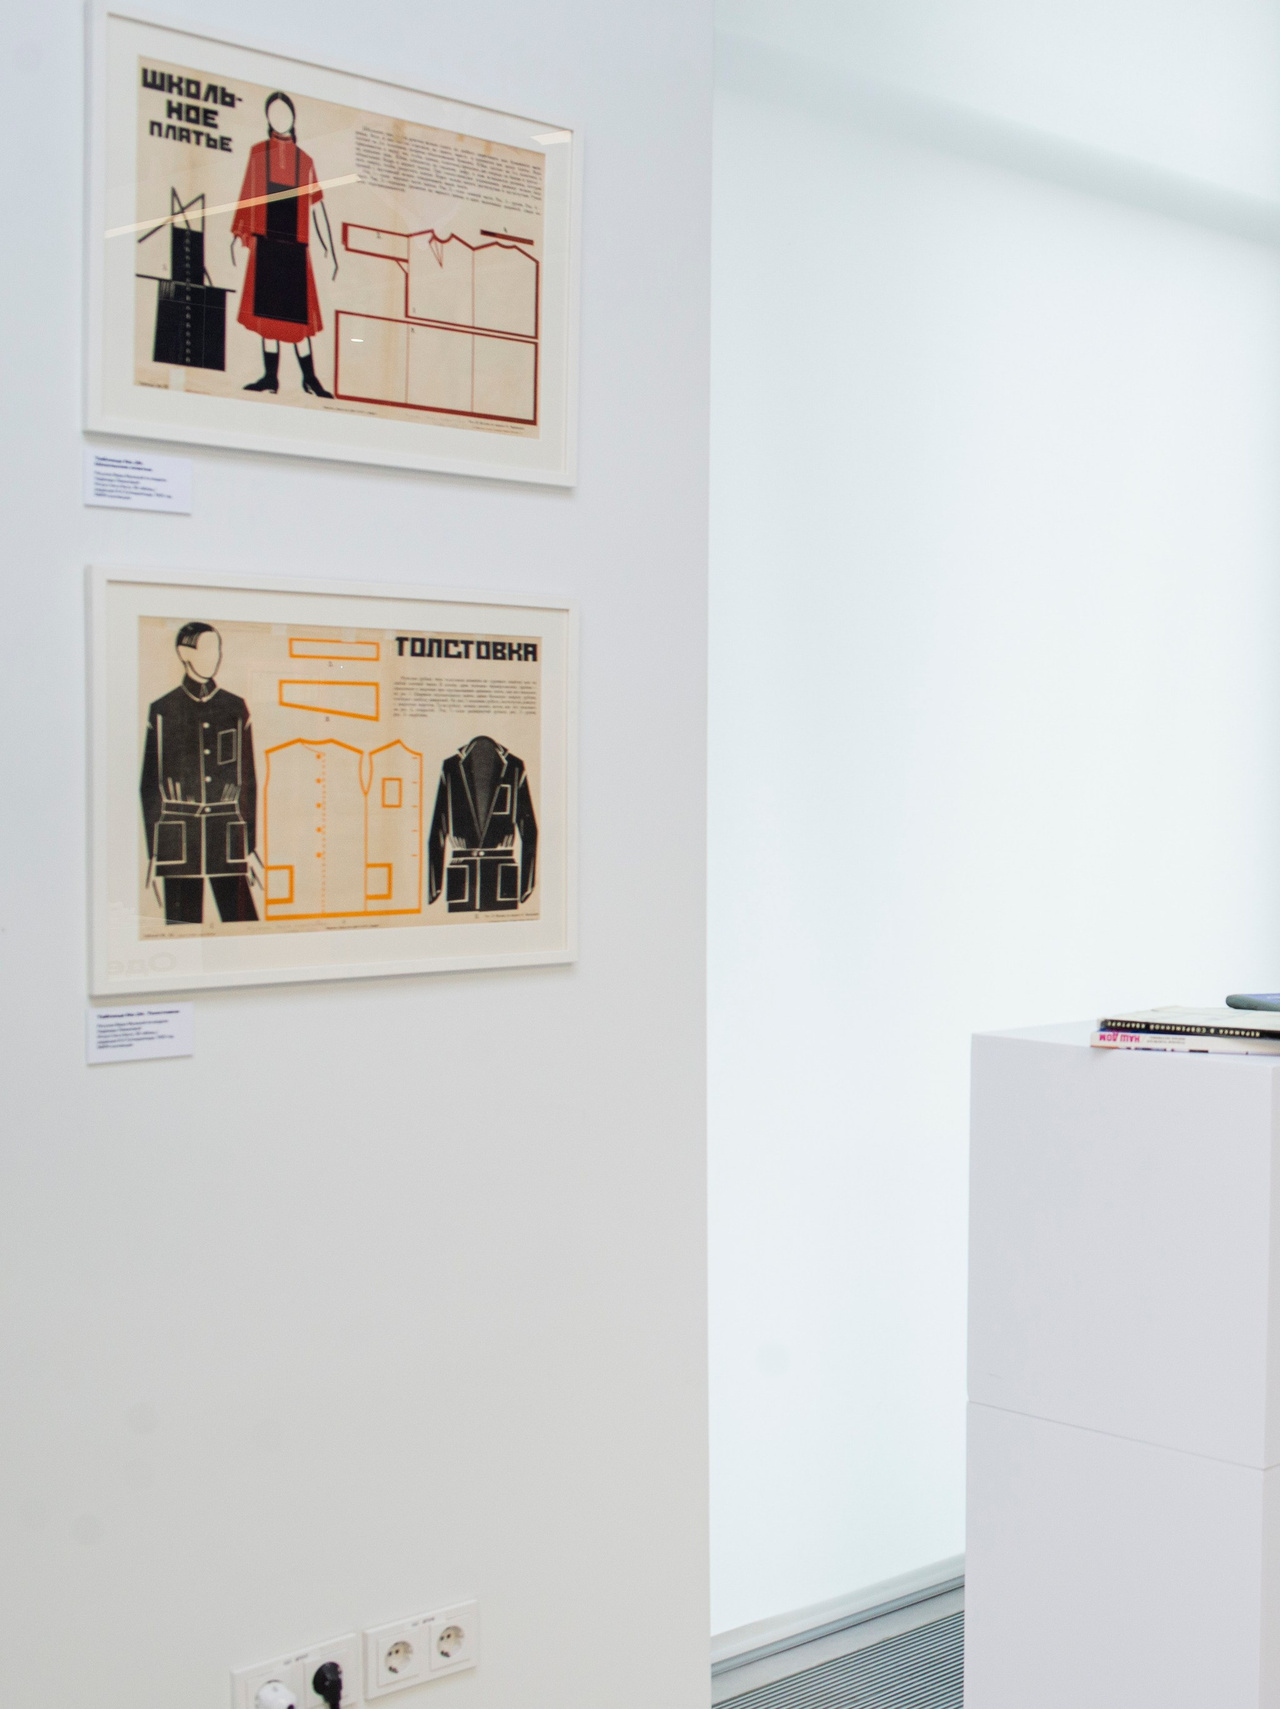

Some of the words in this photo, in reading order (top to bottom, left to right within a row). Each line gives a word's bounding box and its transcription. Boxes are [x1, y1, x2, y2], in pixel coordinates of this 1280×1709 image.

[142, 67, 242, 108] ШКОЛЬ-
[166, 99, 218, 129] НОЕ
[149, 120, 232, 152] ПЛАТЬЕ
[395, 636, 538, 662] ТОЛСТОВКА
[1099, 1031, 1119, 1042] ДОМ
[1120, 1034, 1140, 1043] НАШ
